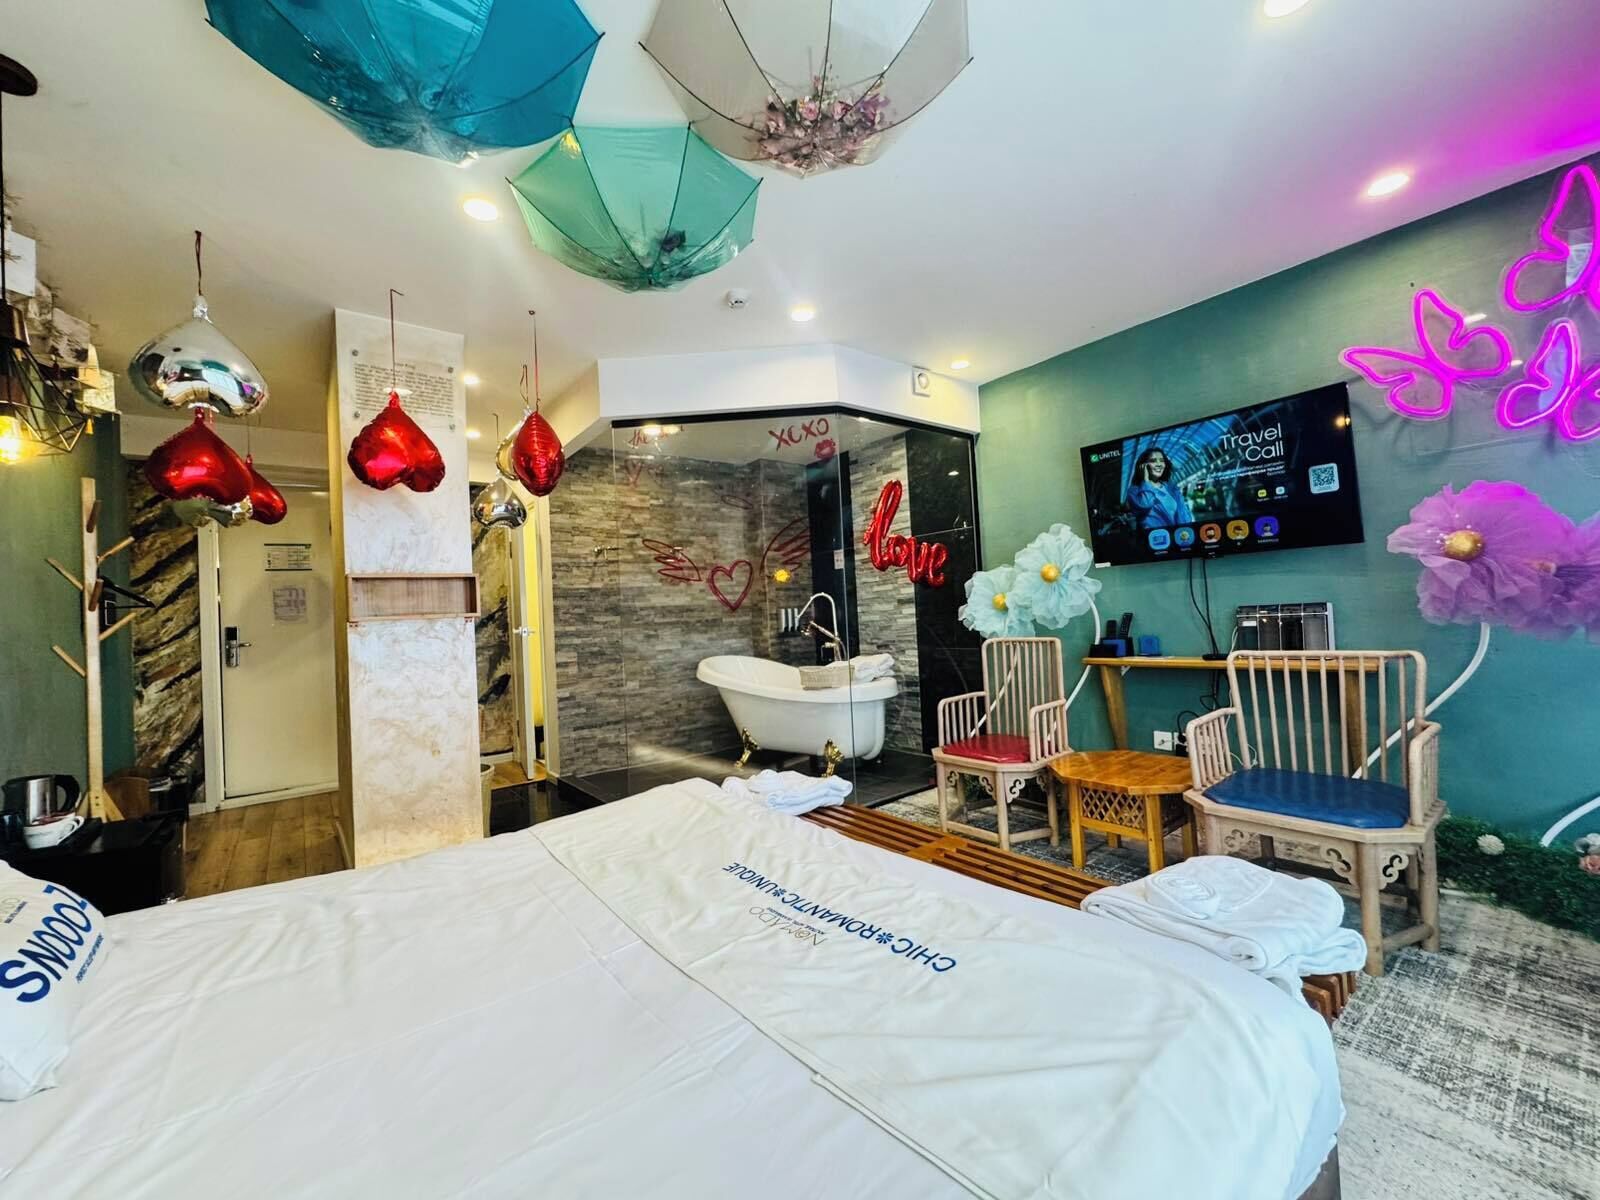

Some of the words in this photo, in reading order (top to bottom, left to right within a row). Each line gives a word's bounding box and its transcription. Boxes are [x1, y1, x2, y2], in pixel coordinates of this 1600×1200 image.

[1219, 422, 1282, 450] Travel
[1245, 440, 1284, 461] Call
[1099, 450, 1121, 460] UNITEL
[863, 480, 949, 588] love
[722, 862, 779, 894] UNIQUE
[781, 892, 877, 940] ROMANTIC
[891, 938, 957, 973] CHIC
